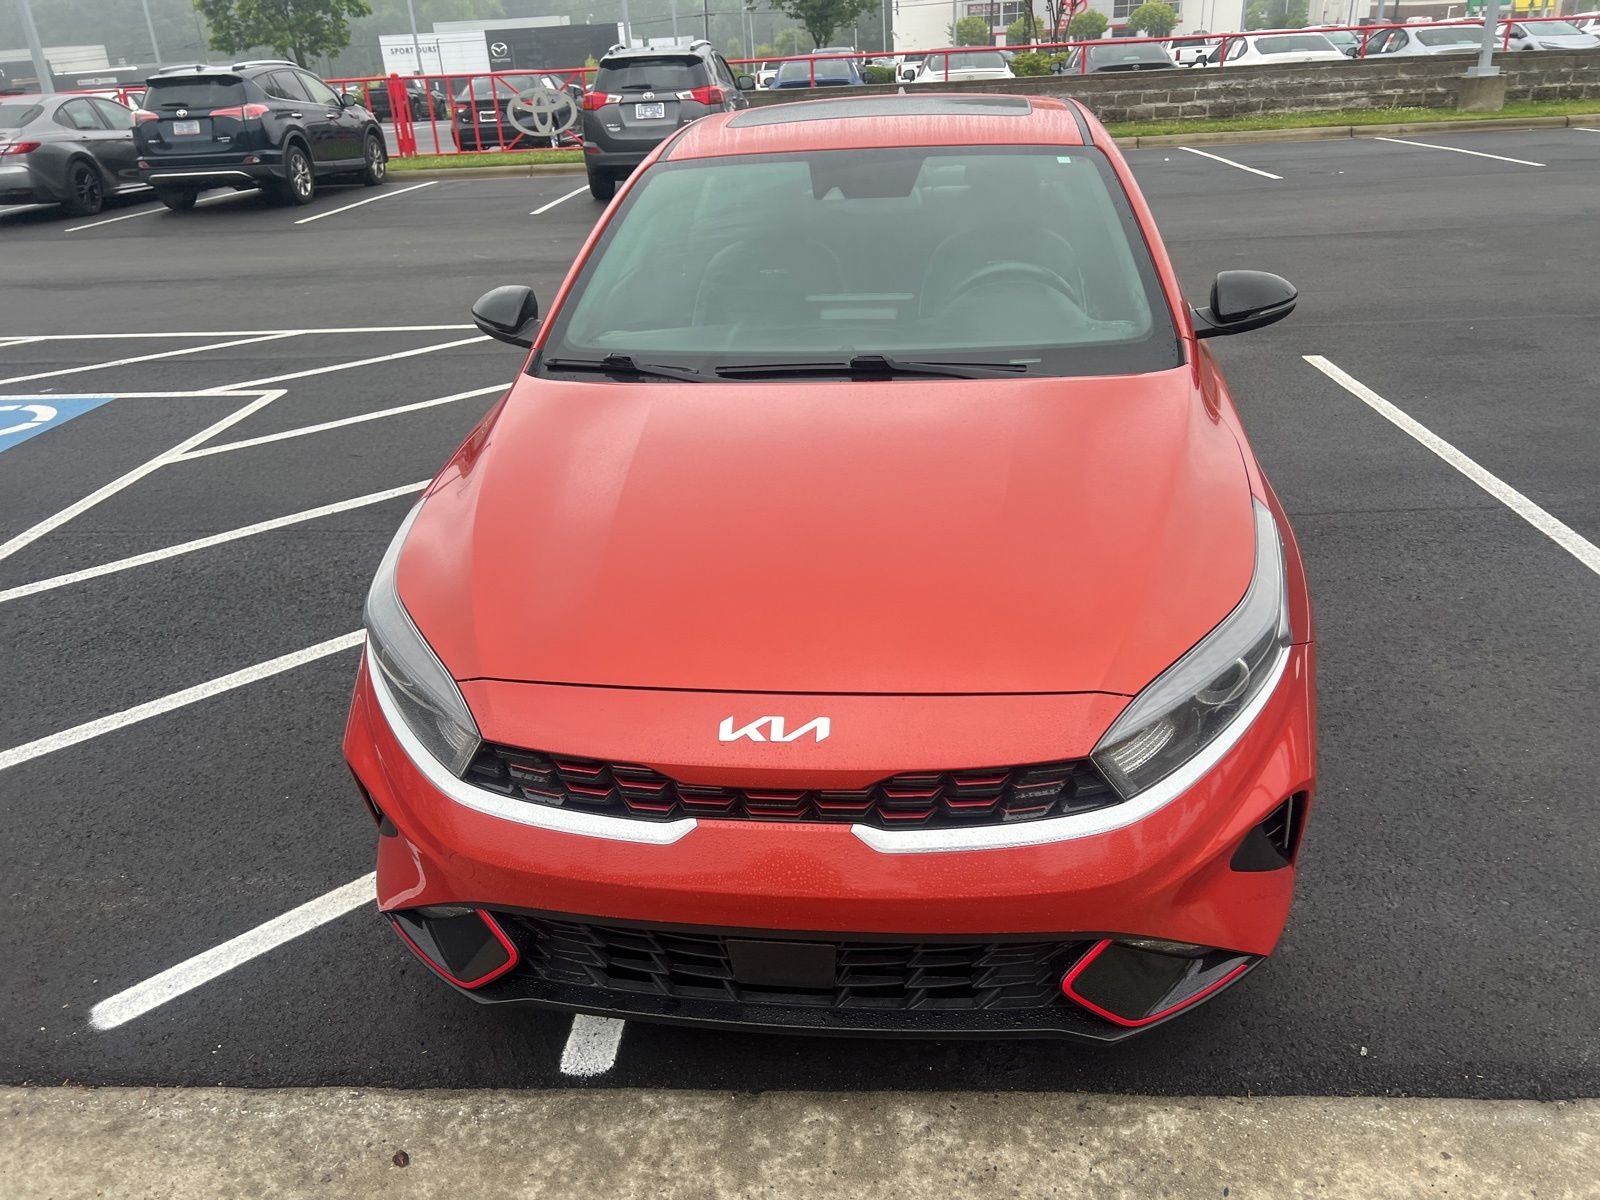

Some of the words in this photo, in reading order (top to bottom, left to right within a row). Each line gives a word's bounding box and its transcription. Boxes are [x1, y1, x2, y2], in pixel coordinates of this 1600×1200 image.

[390, 47, 414, 55] SPORT
[417, 45, 440, 54] DURS
[718, 715, 831, 743] KIA
